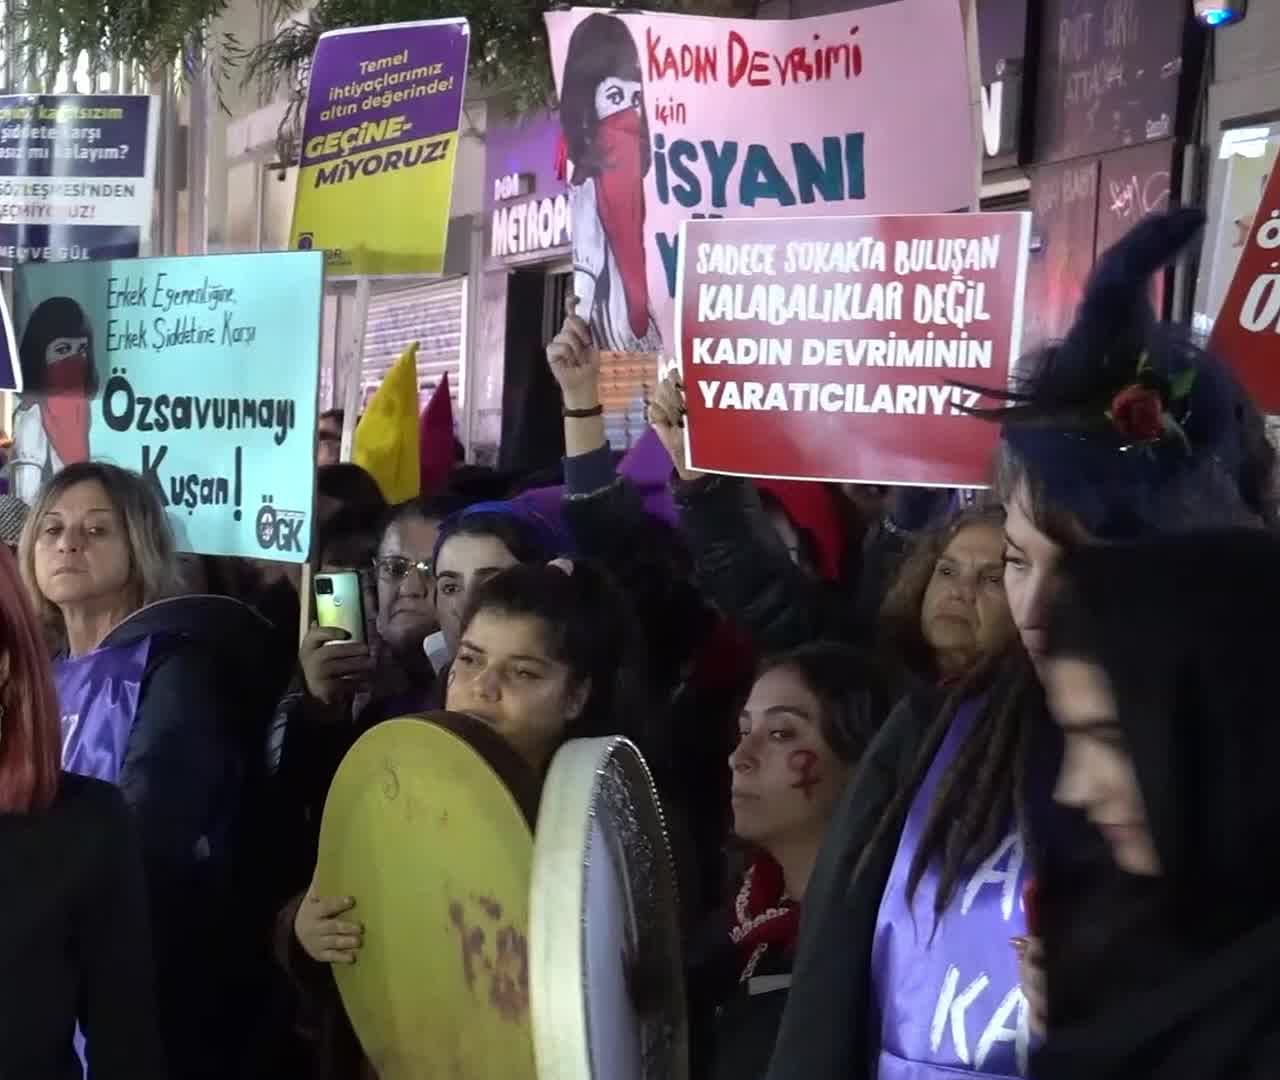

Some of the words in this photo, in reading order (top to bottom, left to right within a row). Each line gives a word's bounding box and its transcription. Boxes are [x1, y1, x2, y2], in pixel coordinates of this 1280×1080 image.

[360, 50, 409, 75] Temel
[646, 28, 717, 83] KADIN
[727, 26, 863, 88] DEVRİMİ
[320, 100, 358, 122] altın
[362, 77, 454, 111] değerinde!
[329, 63, 443, 101] ihtiyaçlarımız
[655, 98, 687, 127] için
[304, 115, 413, 158] GEÇİNE-
[314, 138, 451, 188] MİYORUZ!
[654, 133, 865, 208] İSYANI
[491, 194, 572, 256] METROP
[696, 242, 777, 275] SADECE
[784, 237, 885, 274] SOKAKTA
[894, 235, 1000, 280] BULUŞAN
[106, 276, 148, 309] Erkek
[697, 282, 904, 326] KALABALIKLAR
[913, 275, 991, 329] DEĞİL
[106, 319, 148, 352] Erkek
[151, 314, 216, 352] Şiddetine
[692, 338, 792, 366] KADIN
[801, 331, 993, 369] DEVRİMİNİN
[102, 367, 296, 445] Özsavunmayı
[255, 494, 305, 553] ÖGK
